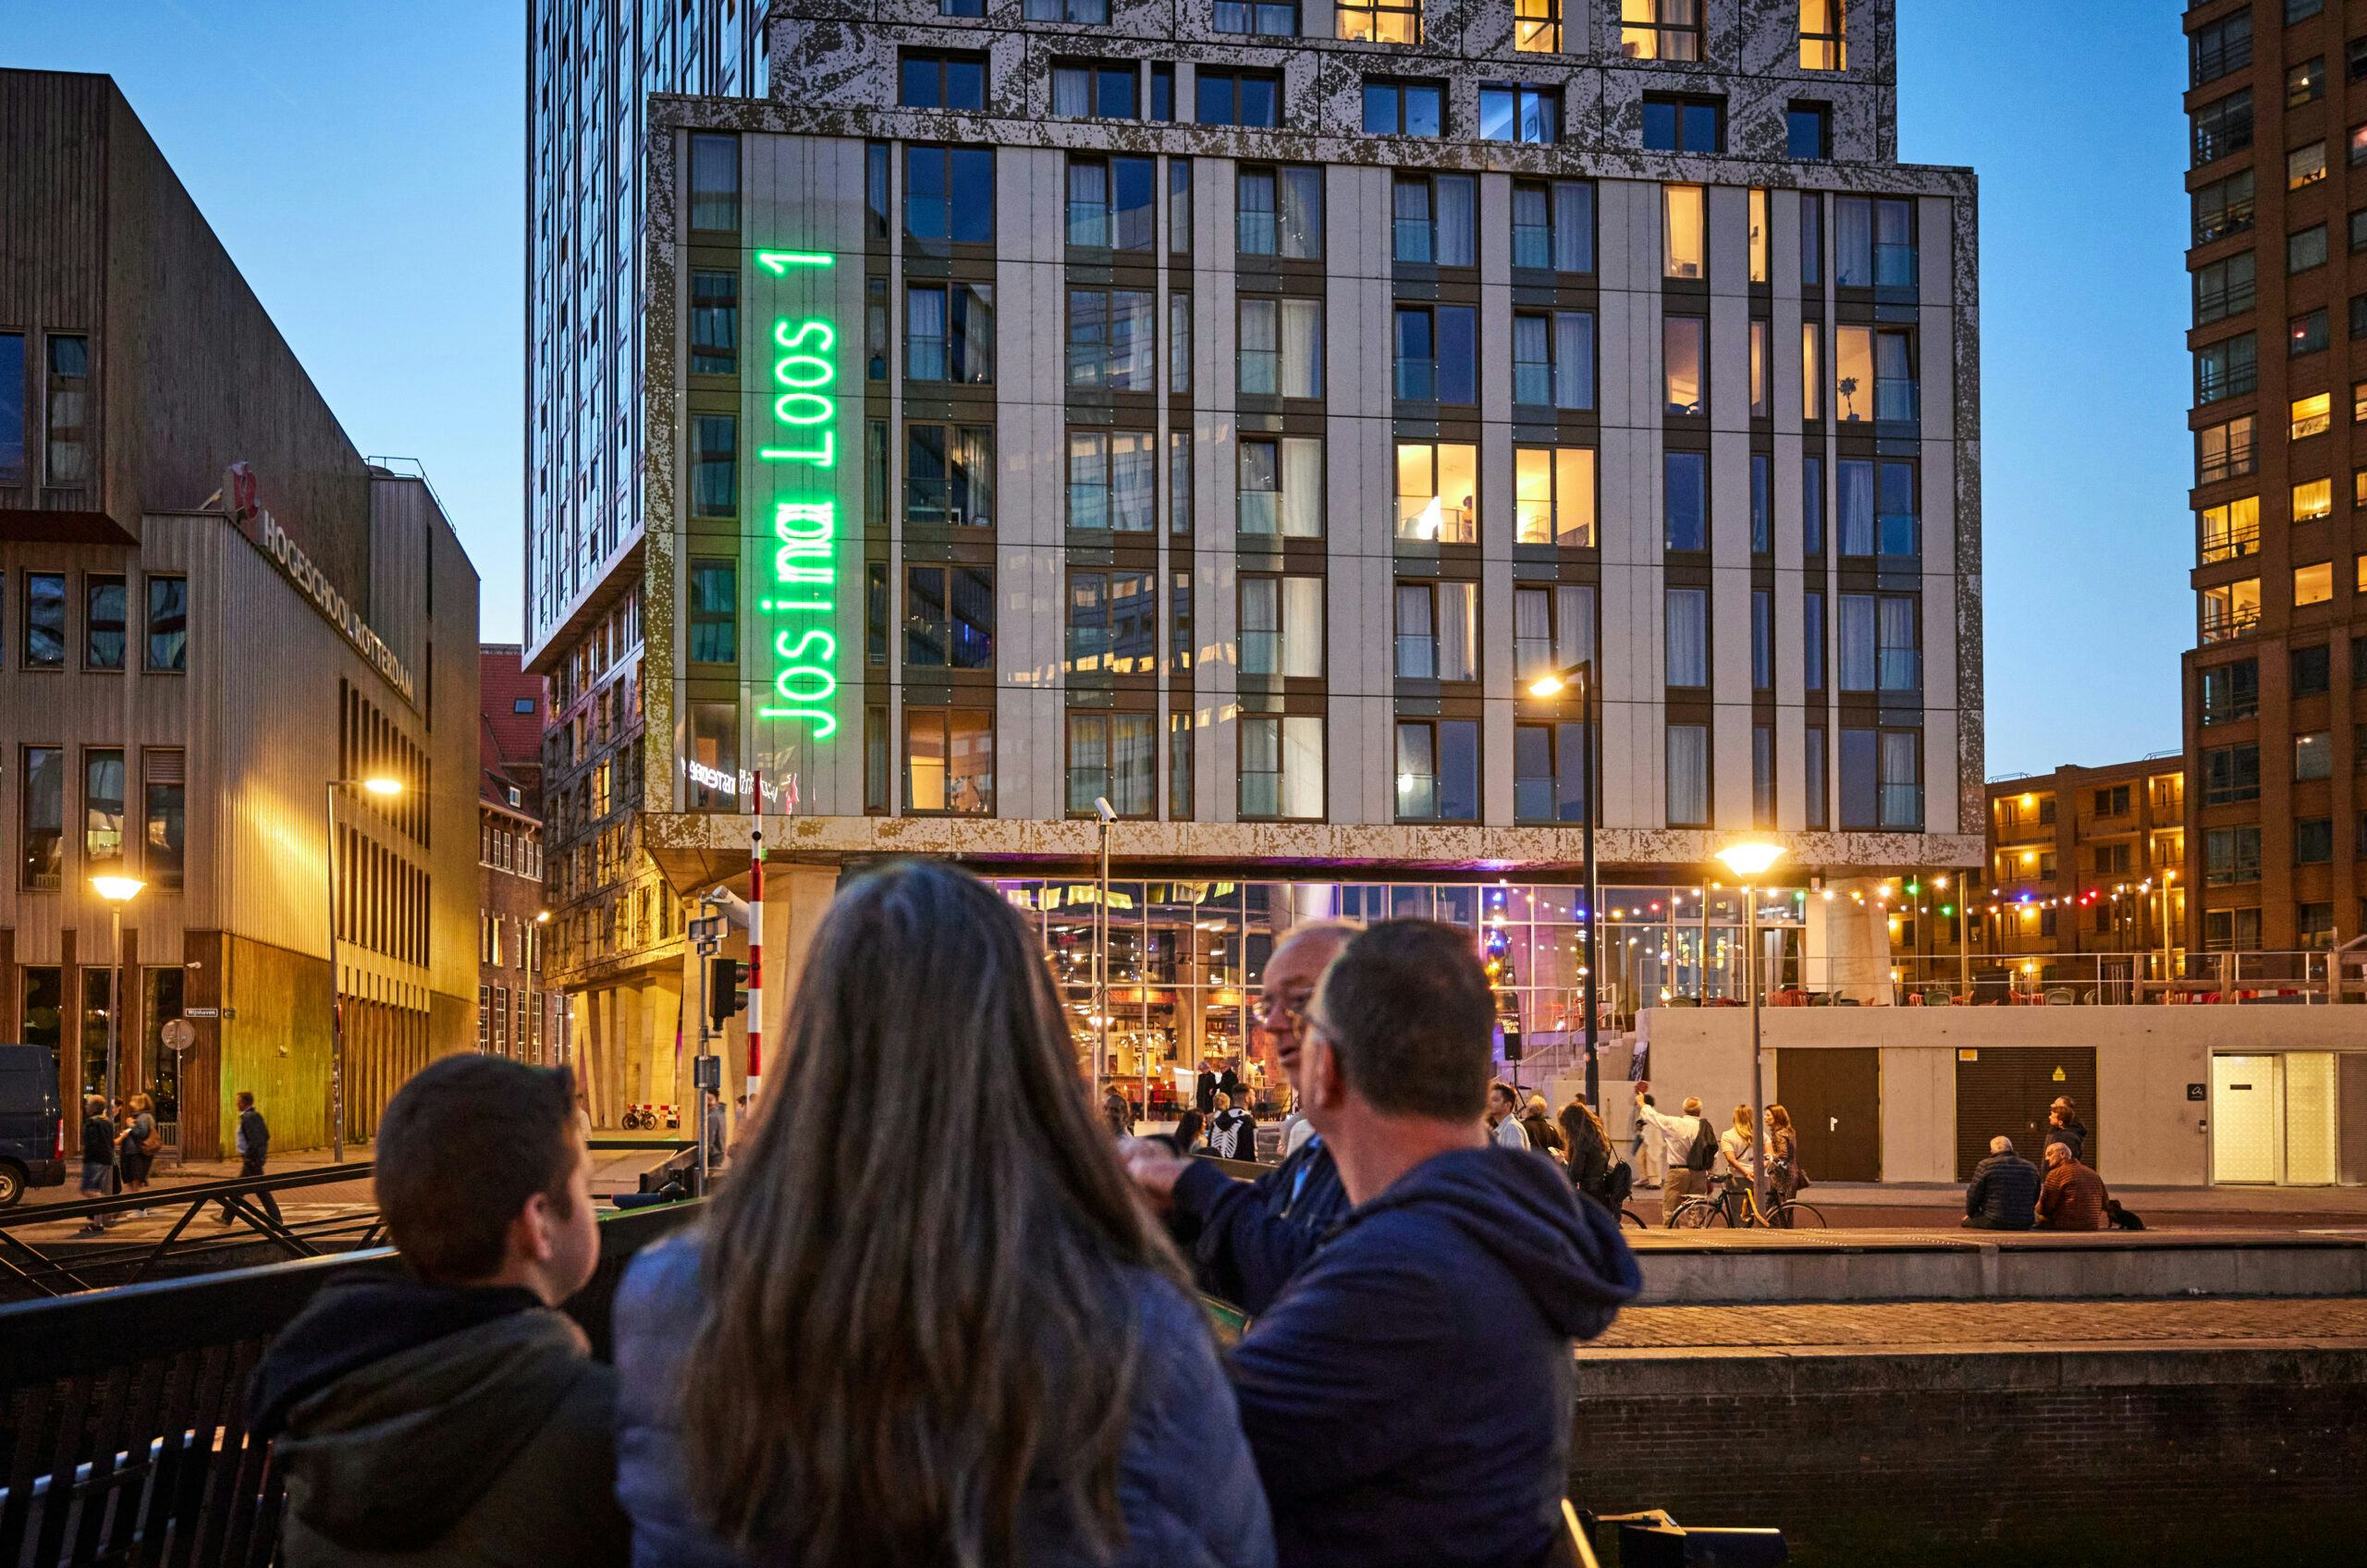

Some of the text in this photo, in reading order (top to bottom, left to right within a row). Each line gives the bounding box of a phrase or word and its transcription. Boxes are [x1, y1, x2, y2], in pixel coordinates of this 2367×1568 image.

[756, 249, 834, 276] 1
[758, 319, 836, 468] Loos
[261, 508, 414, 702] HOGESCHOOL ROTTERDAM
